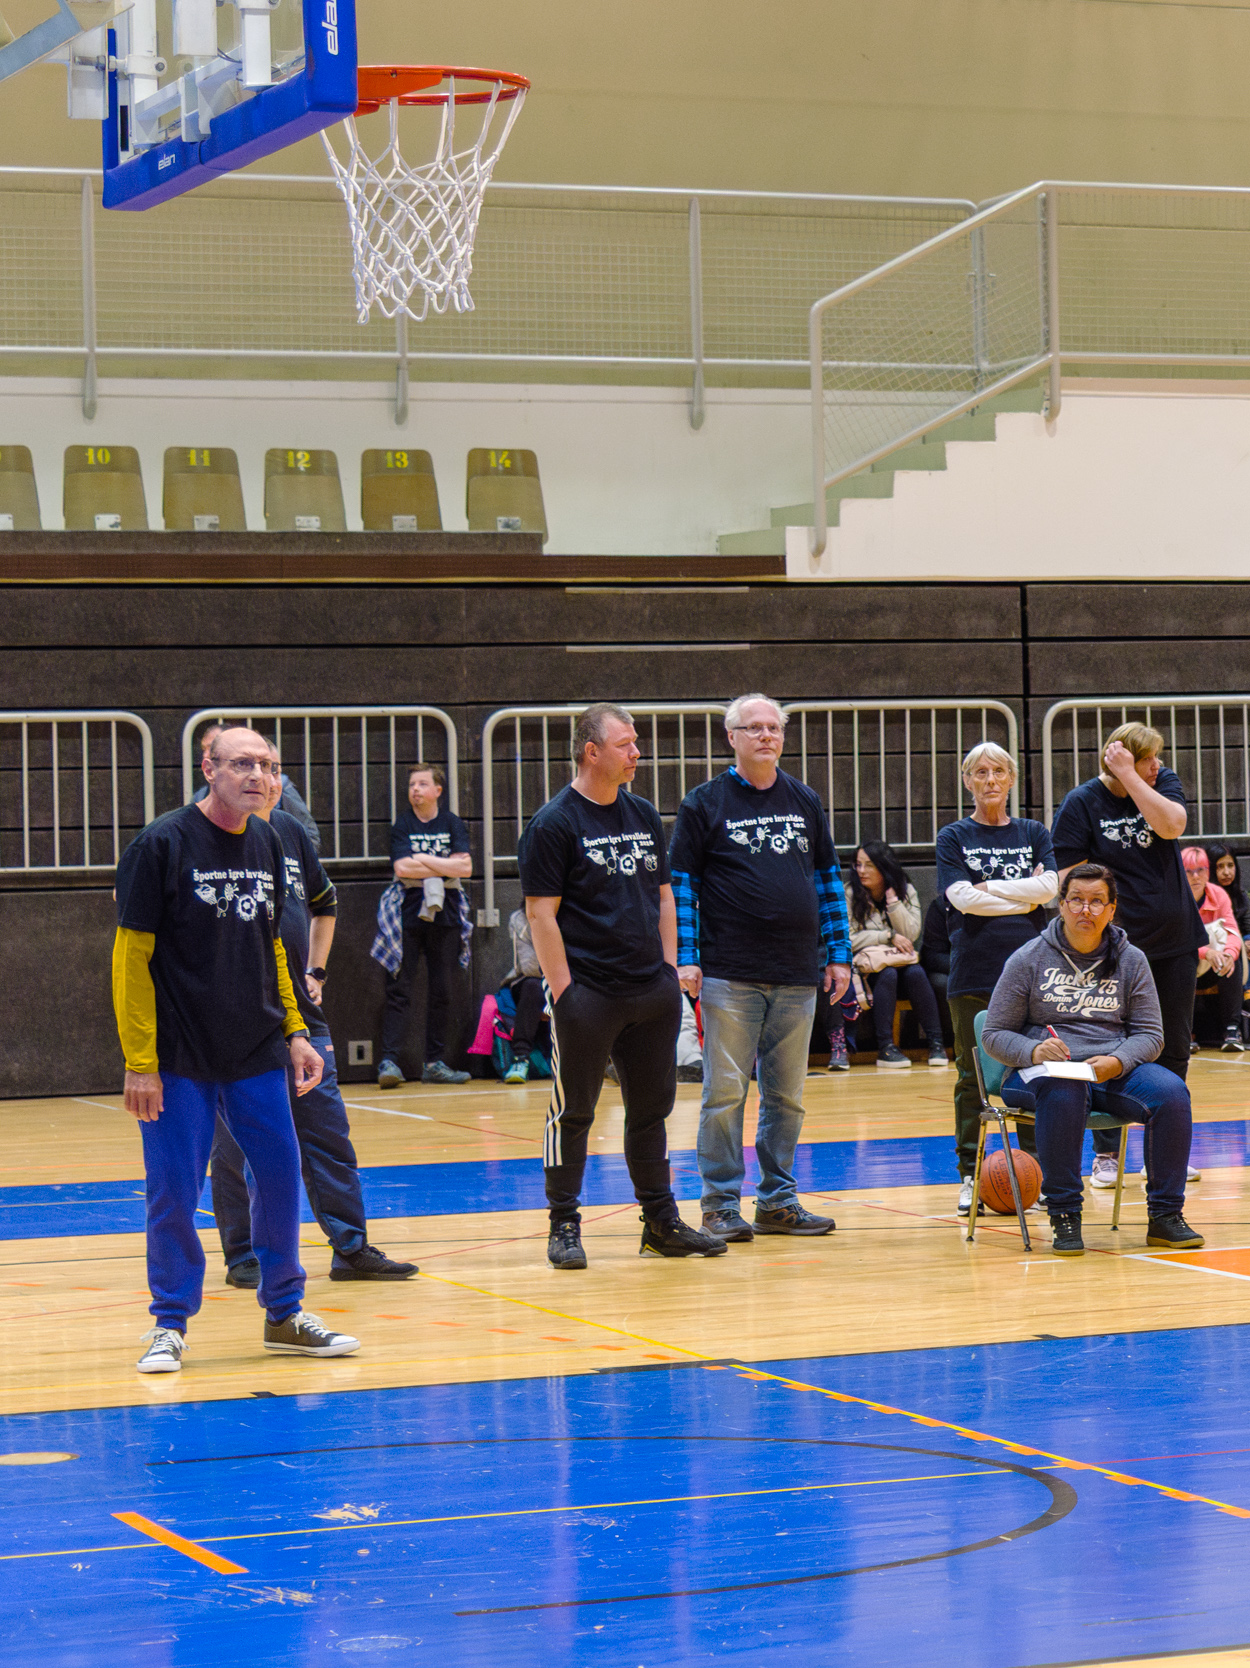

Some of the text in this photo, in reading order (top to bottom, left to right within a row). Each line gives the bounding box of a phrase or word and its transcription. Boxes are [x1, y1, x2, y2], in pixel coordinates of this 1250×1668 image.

[321, 0, 339, 56] ela
[158, 153, 176, 171] elan
[85, 448, 111, 466] 10
[187, 449, 211, 467] 11
[287, 451, 312, 468] 12
[386, 451, 409, 469] 13
[489, 451, 512, 469] 14
[726, 819, 758, 831] Športne
[757, 816, 774, 826] igre
[193, 868, 228, 883] Športne
[227, 868, 245, 881] igre
[1098, 980, 1119, 995] 75
[1042, 991, 1120, 1014] Denim Jones
